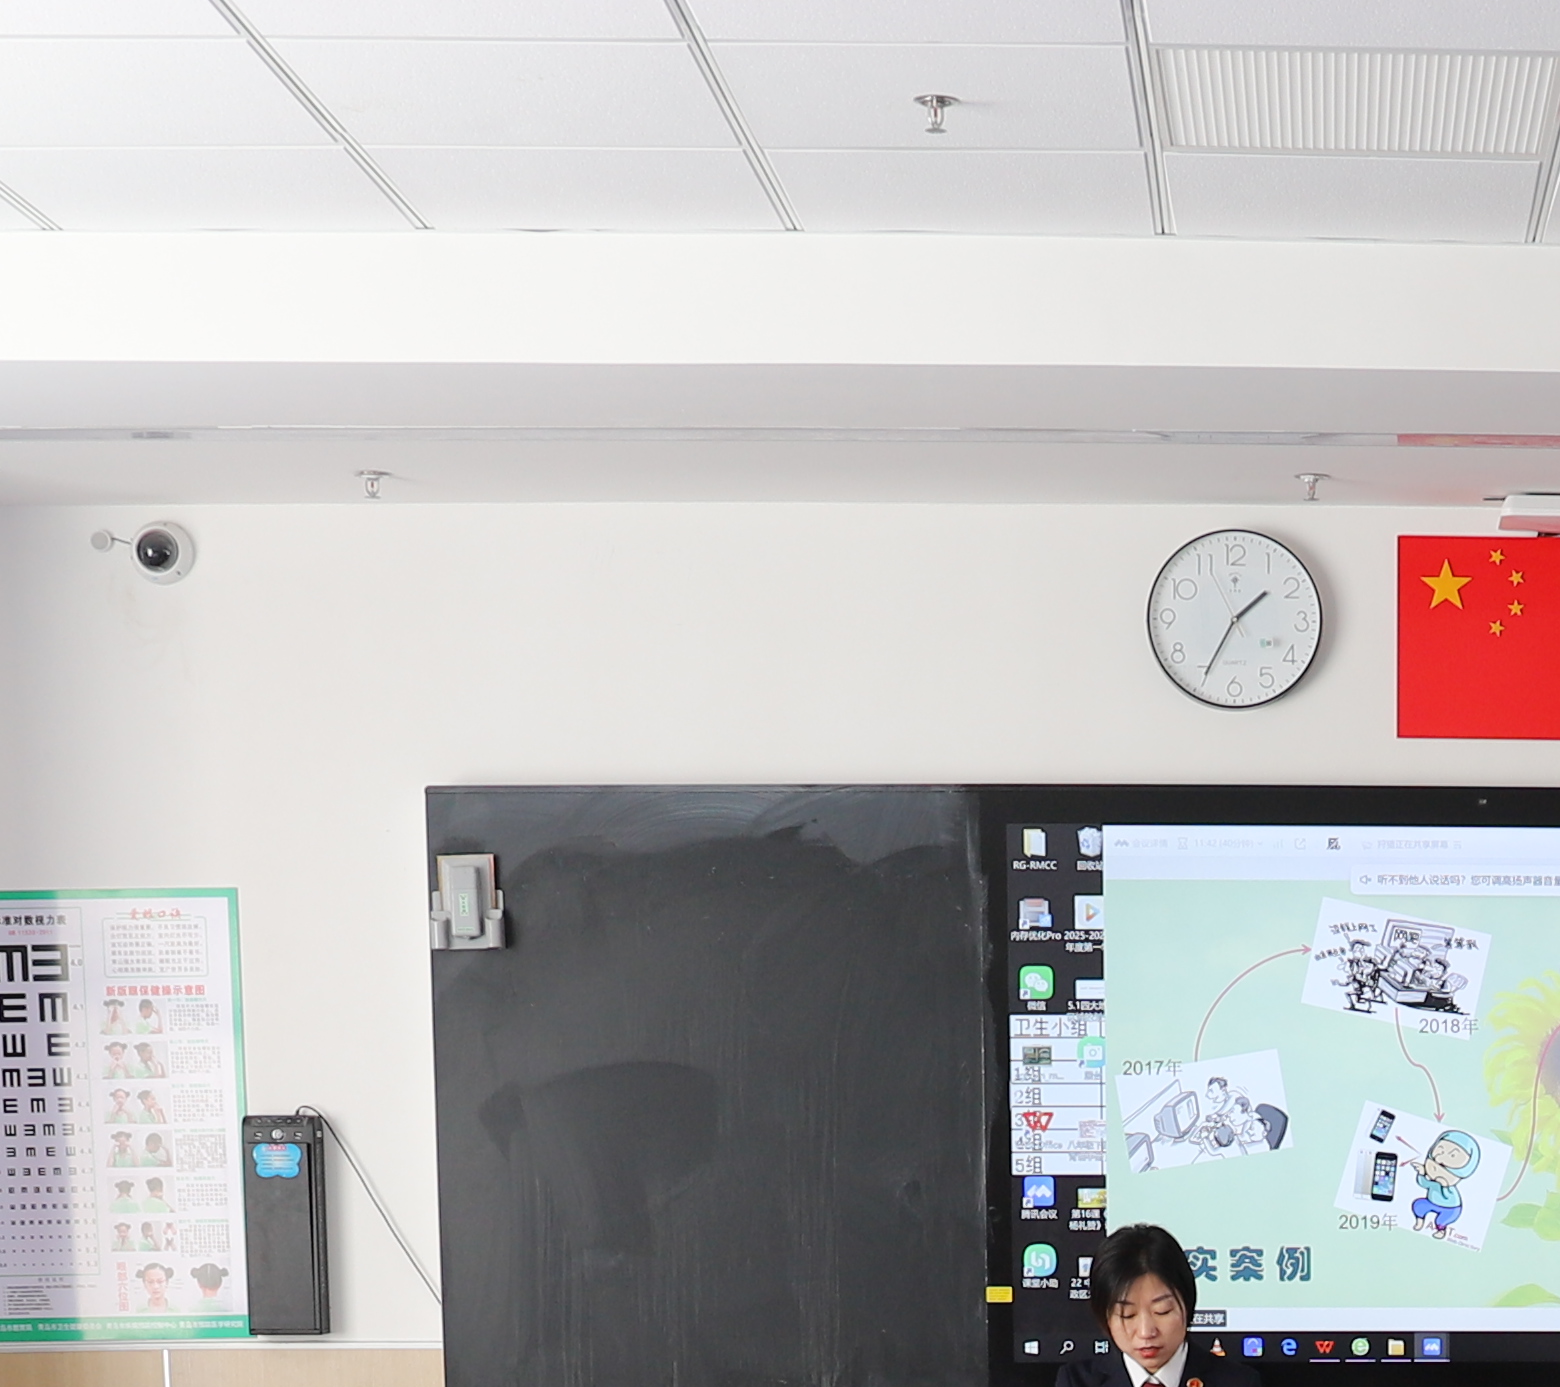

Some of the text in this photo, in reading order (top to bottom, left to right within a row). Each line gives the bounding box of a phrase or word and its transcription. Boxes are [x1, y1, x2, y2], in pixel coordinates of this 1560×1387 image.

[1196, 553, 1213, 576] 11
[1224, 543, 1246, 566] 12
[1266, 552, 1271, 575] 1
[1171, 577, 1198, 601] 10
[1283, 577, 1300, 599] 2
[1159, 608, 1176, 630] 9
[1294, 610, 1310, 632] 3
[1170, 642, 1186, 664] 8
[1282, 644, 1297, 666] 4
[1227, 676, 1243, 697] 6
[1259, 667, 1274, 689] 5
[1013, 861, 1057, 870] RG-RMCC
[1065, 942, 1104, 952] 年度第一
[1014, 1017, 1088, 1037] 卫生小组
[1419, 1017, 1479, 1035] 2018年
[1122, 1059, 1183, 1077] 2017年
[1014, 1087, 1042, 1106] 2组
[1015, 1155, 1043, 1174] 5组
[1338, 1213, 1398, 1231] 2019年
[1185, 1246, 1311, 1282] 实案例
[1190, 1313, 1225, 1325] 在共享
